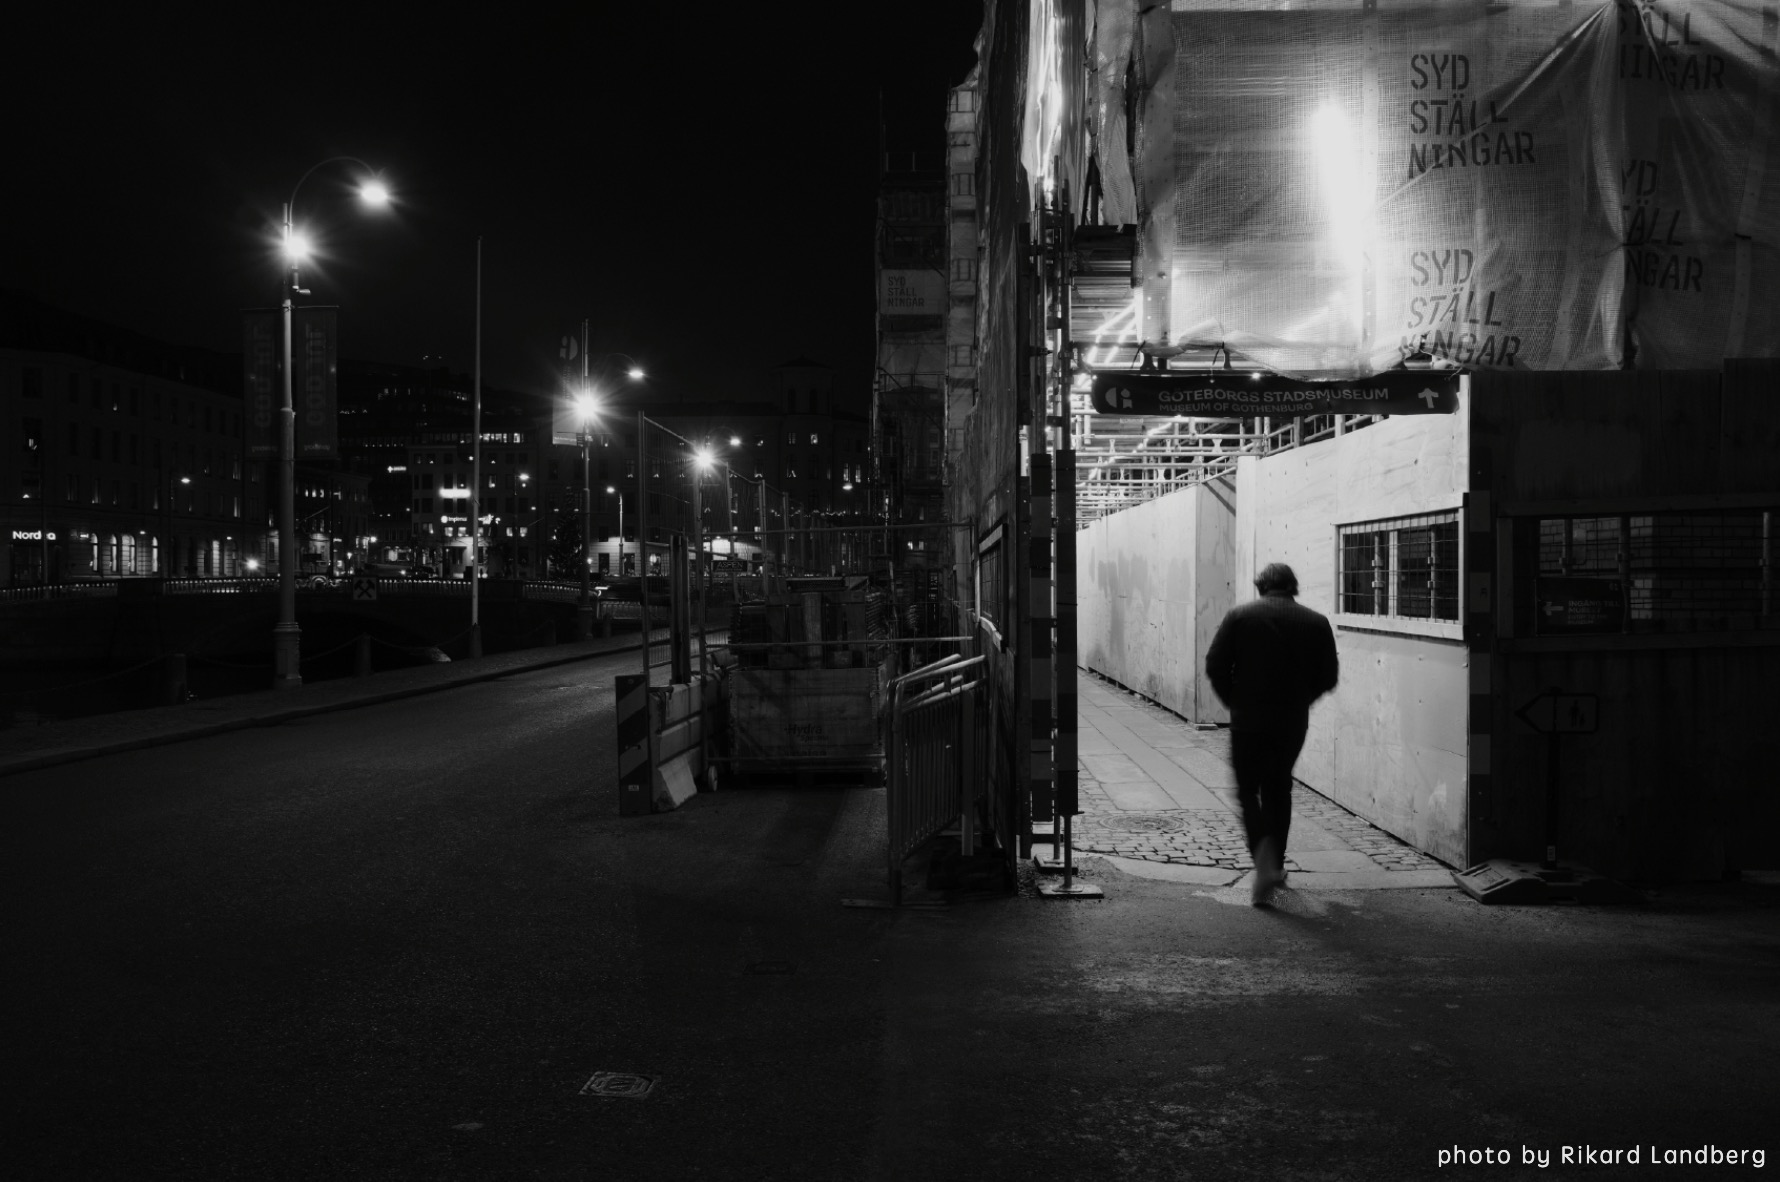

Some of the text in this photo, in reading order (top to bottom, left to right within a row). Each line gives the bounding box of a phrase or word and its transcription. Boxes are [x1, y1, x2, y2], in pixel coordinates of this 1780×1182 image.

[1411, 54, 1469, 90] SYD
[1411, 93, 1508, 135] STÄLL
[1409, 131, 1535, 179] NINGAR
[1621, 160, 1657, 196] YD
[888, 276, 906, 286] SYD
[1411, 249, 1474, 286] SYD
[1626, 249, 1703, 292] NGAR
[887, 297, 925, 307] NINGAR
[1408, 286, 1502, 329] STÄLL
[1159, 402, 1314, 413] MUSEUM OF GOTHENBURG
[1263, 388, 1389, 403] STADSMUSEUM
[12, 530, 56, 541] Norda
